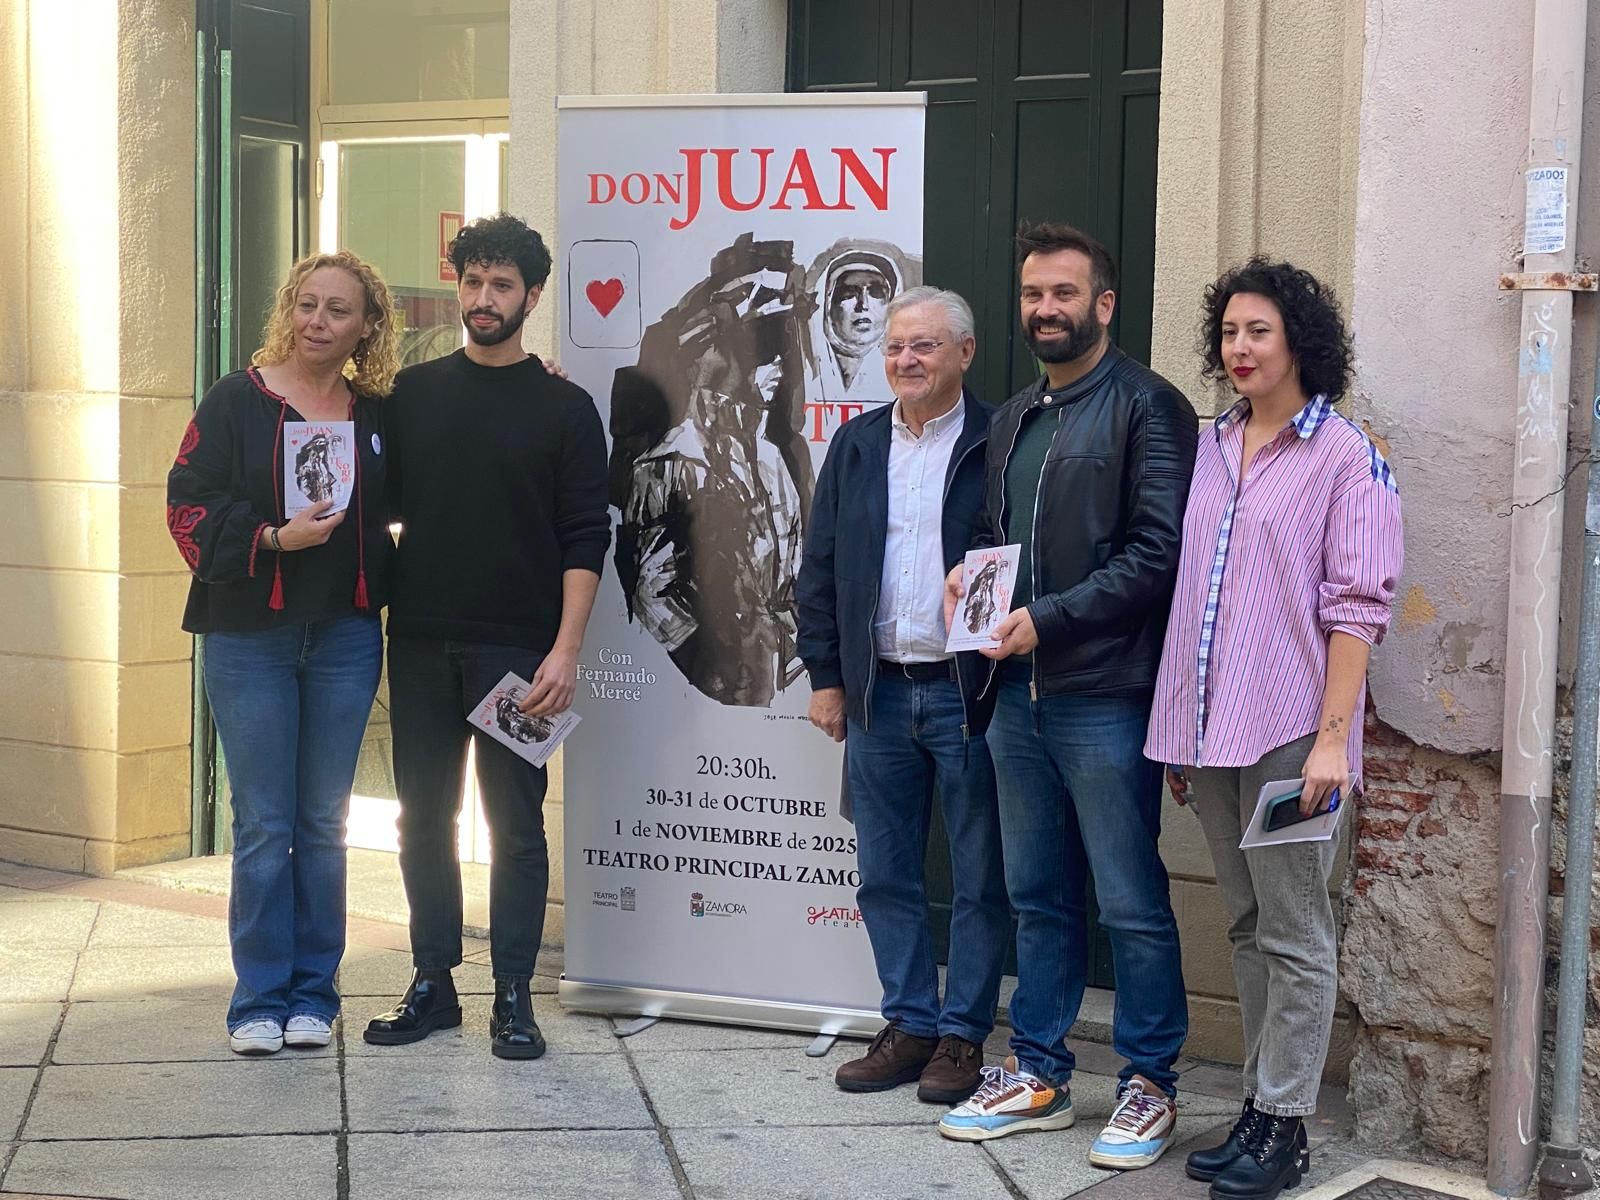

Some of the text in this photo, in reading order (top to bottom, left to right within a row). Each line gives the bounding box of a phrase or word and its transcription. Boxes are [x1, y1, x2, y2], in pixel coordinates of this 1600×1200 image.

[586, 148, 897, 230] DON JUAN
[599, 648, 633, 665] Con
[576, 665, 656, 685] Fernando
[590, 683, 641, 701] Mercé
[696, 755, 777, 780] 20:30h.
[645, 788, 827, 818] 30-31 de OCTUBRE
[614, 818, 857, 855] 1 de NOVIEMBRE de 2025
[583, 848, 863, 888] TEATRO PRINCIPAL ZAMO
[593, 891, 618, 900] TEATRO
[705, 901, 747, 915] ZAMORA
[823, 918, 860, 928] teat
